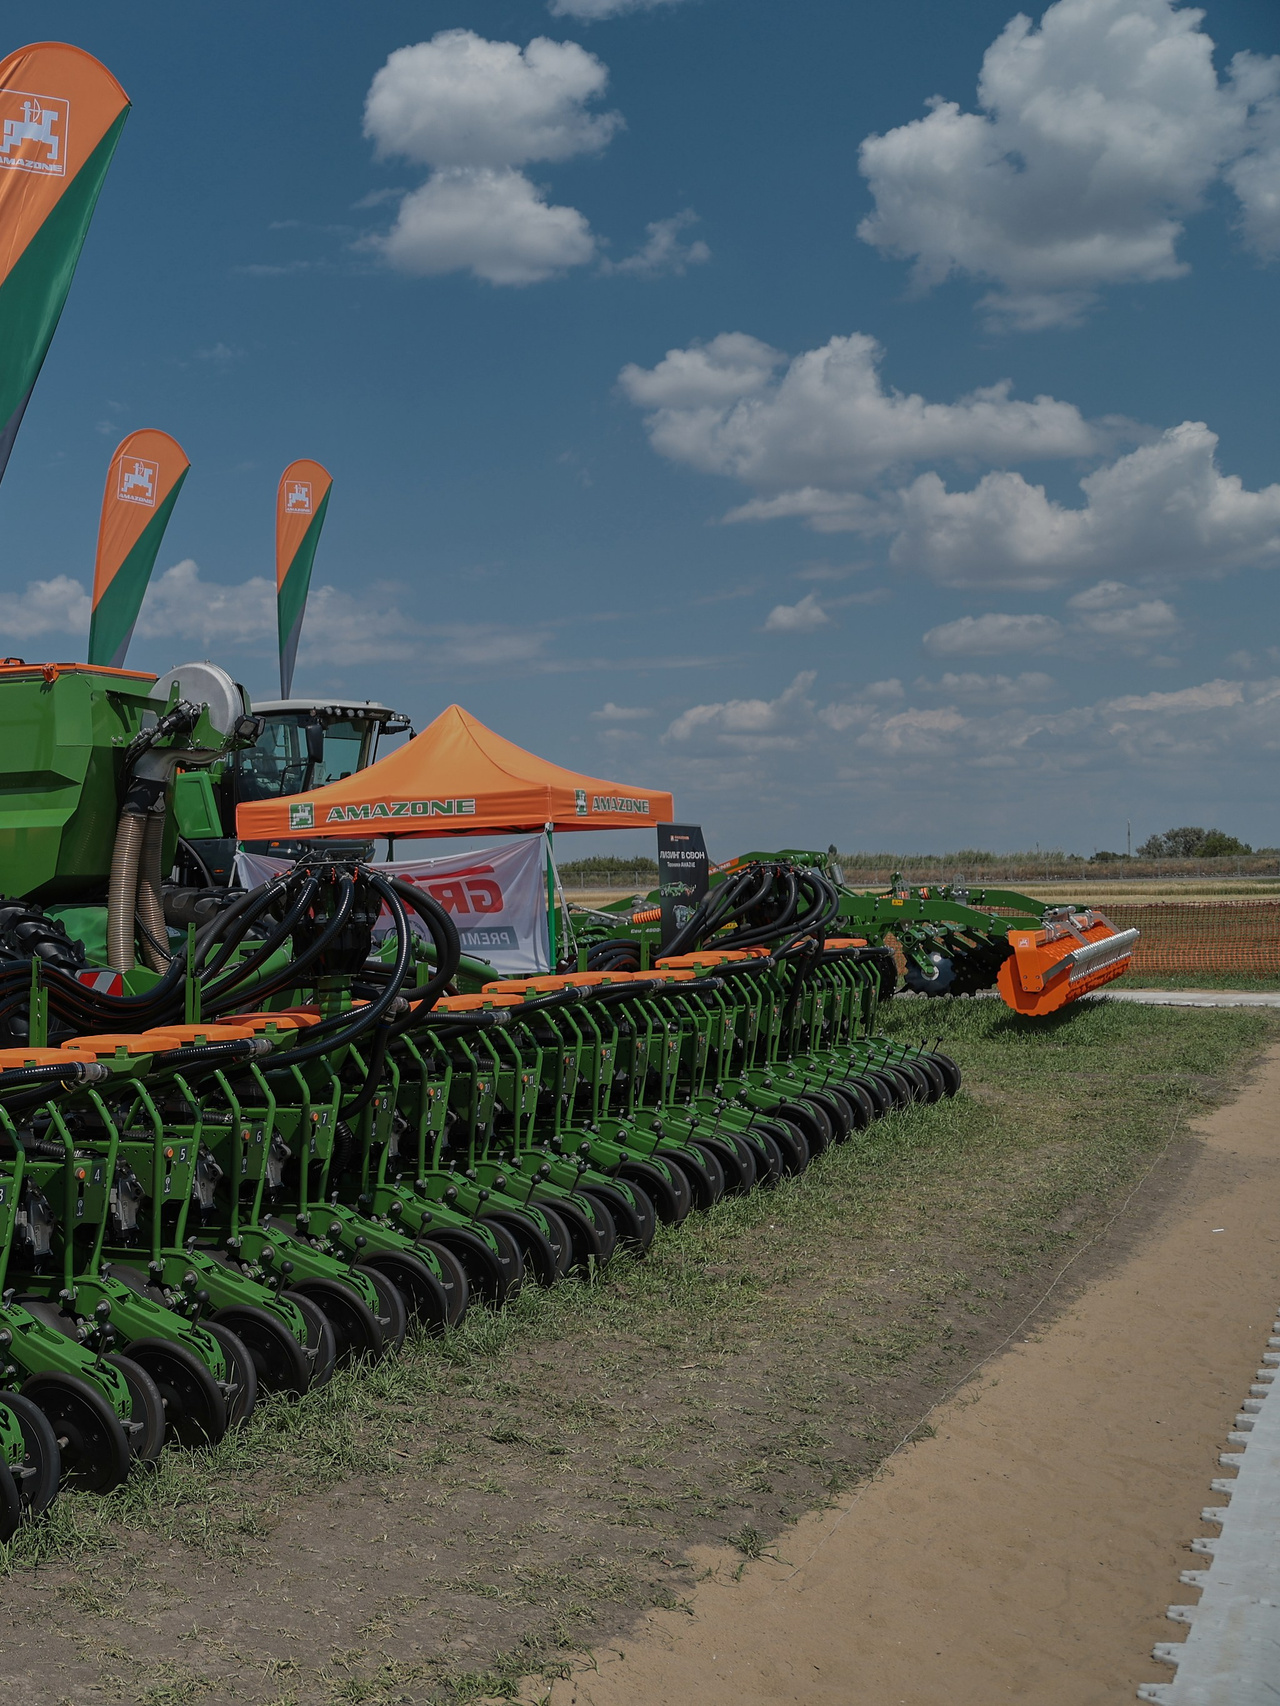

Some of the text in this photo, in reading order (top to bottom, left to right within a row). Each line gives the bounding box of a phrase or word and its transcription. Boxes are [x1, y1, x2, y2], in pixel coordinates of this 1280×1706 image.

[119, 493, 154, 506] AMAZONE
[326, 798, 476, 823] AMAZONE
[592, 795, 650, 815] AMAZONE
[436, 1088, 442, 1100] 9
[382, 1098, 388, 1110] 8
[322, 1112, 328, 1124] 7
[256, 1130, 262, 1143] 6
[179, 1148, 186, 1161] 5
[94, 1169, 101, 1181] 4
